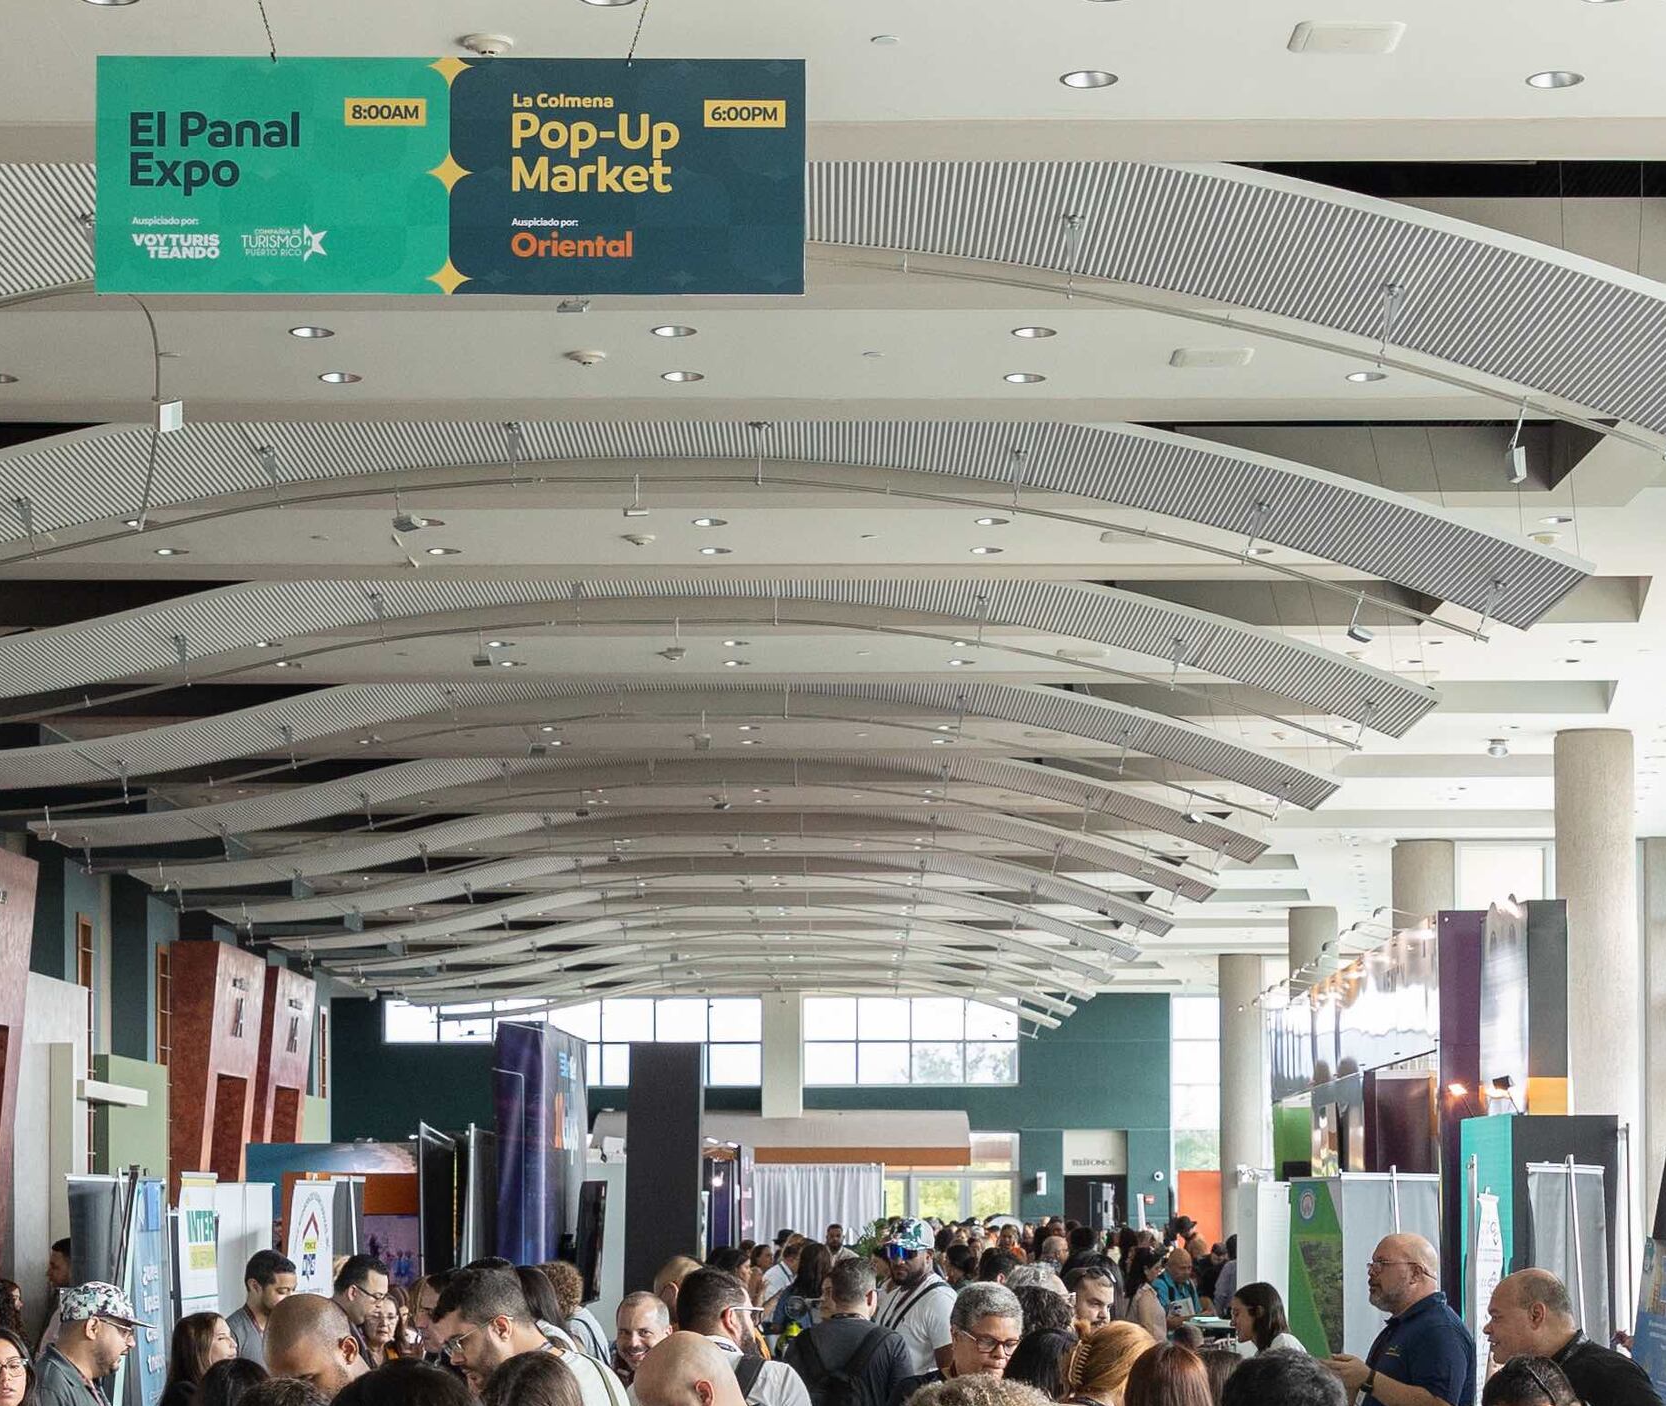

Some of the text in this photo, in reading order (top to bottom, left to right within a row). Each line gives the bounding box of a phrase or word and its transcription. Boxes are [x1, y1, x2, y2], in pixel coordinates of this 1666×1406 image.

[512, 93, 614, 109] La Colmena
[351, 104, 419, 121] 8:00AM
[710, 106, 778, 122] 6:00PM
[129, 111, 300, 148] El Panal
[512, 113, 680, 159] Pop-Up
[129, 151, 240, 197] Expo
[511, 156, 672, 194] Market
[132, 216, 199, 227] Auspiciado por:
[512, 217, 579, 230] Auspiciado por:
[132, 233, 220, 247] VOYTURIS
[241, 235, 302, 248] TURISMO
[511, 230, 634, 258] Oriental
[147, 246, 220, 259] TEANDO
[245, 248, 302, 257] PUERTO RICO
